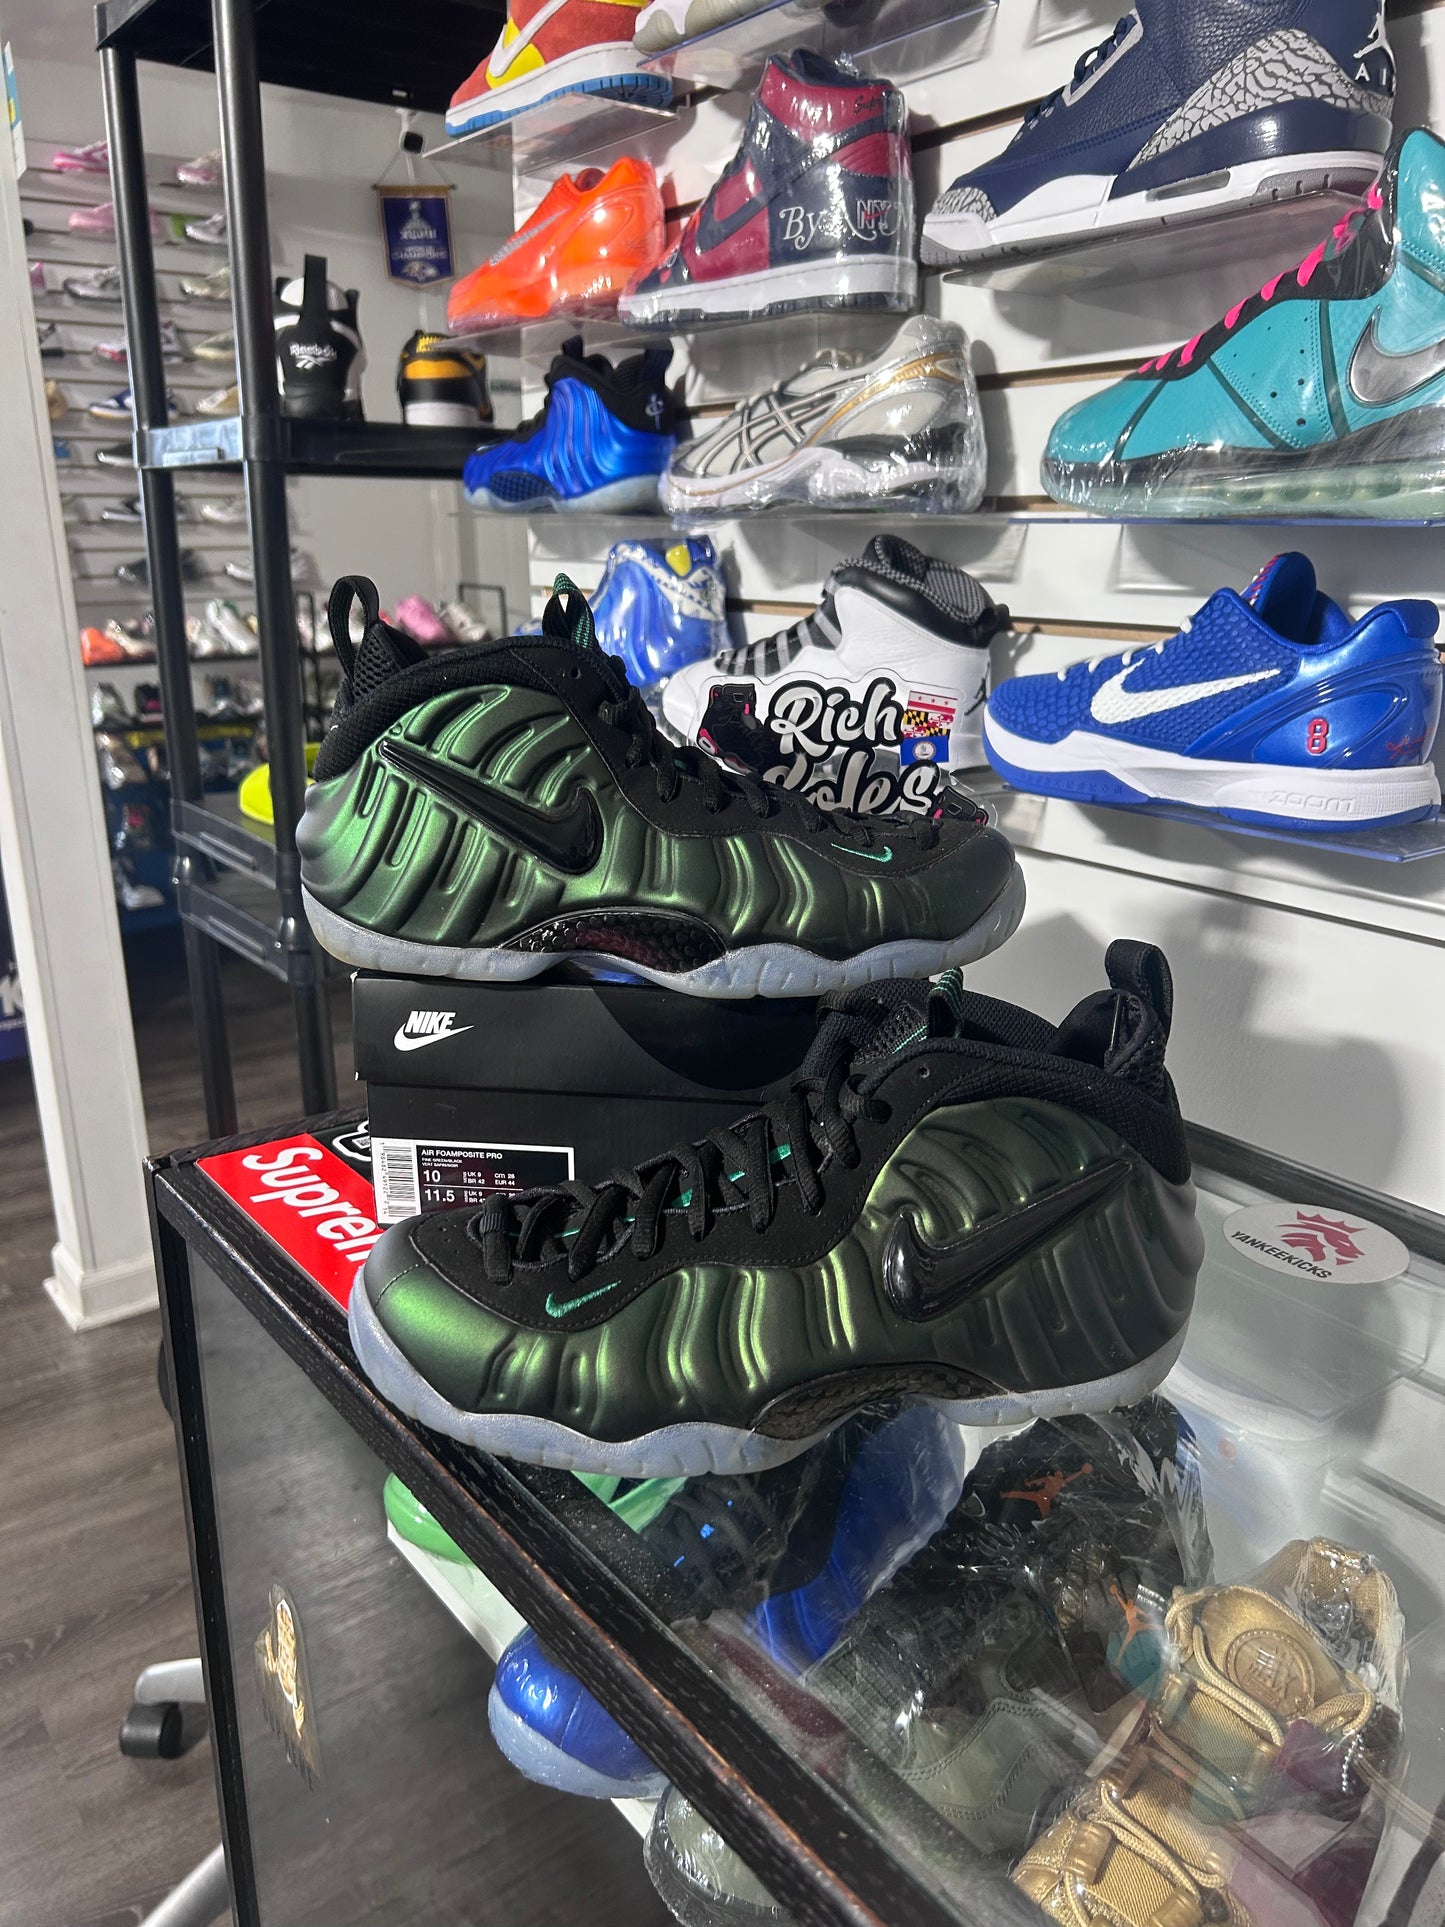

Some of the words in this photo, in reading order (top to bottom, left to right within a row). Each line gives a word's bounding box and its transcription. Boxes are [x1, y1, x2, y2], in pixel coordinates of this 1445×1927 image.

[768, 680, 899, 758] Rich
[1306, 718, 1329, 756] 8
[404, 1010, 456, 1033] NIKE
[436, 1150, 485, 1158] FOAMPOSITE
[486, 1152, 503, 1160] PRO
[423, 1169, 441, 1183] 10
[424, 1189, 455, 1203] 11.5
[1231, 1231, 1333, 1279] YANKEEKICKS
